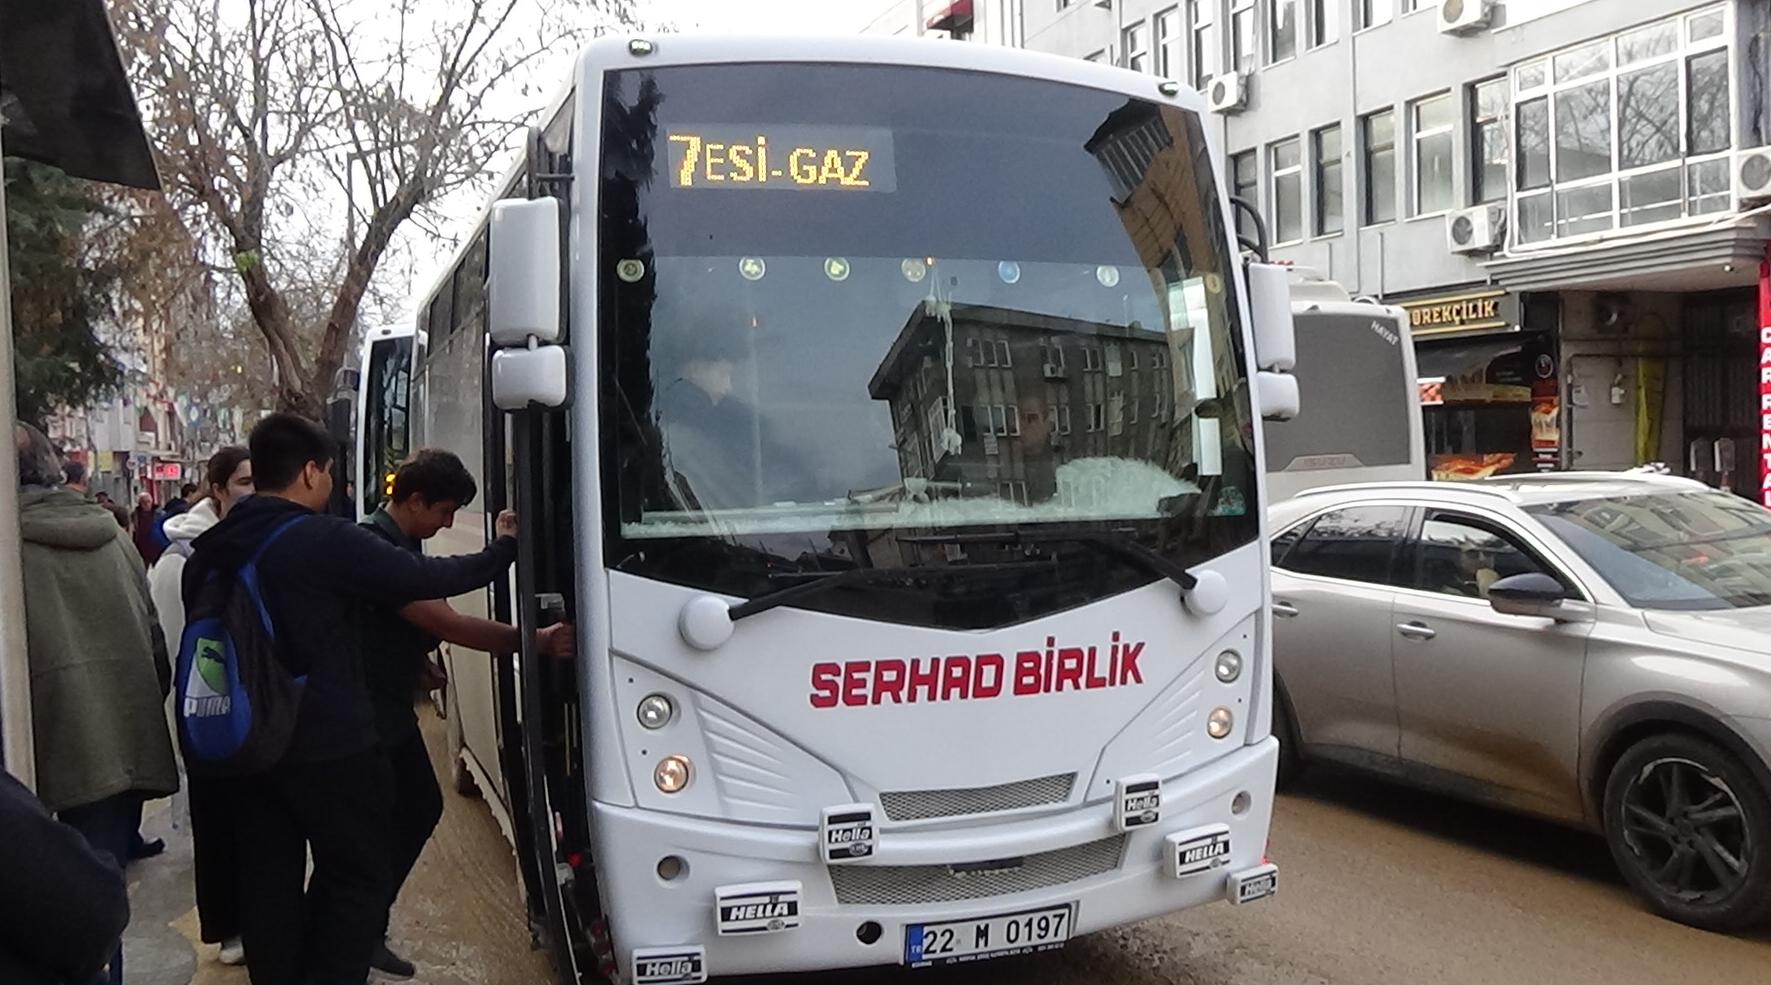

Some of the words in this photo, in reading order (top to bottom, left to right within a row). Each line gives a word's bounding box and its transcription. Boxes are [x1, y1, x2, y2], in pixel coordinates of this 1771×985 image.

[1370, 320, 1400, 346] HAYAT
[809, 652, 1005, 709] SERHAD
[1012, 630, 1146, 696] BİRLİK
[183, 696, 231, 718] PUMA
[1126, 796, 1158, 812] Hella
[830, 827, 870, 843] Hella
[1184, 842, 1225, 863] HELLA
[729, 903, 789, 921] HELLA
[923, 929, 955, 955] 22
[974, 922, 990, 949] M
[1005, 912, 1066, 944] 0197
[645, 960, 693, 977] Hella
